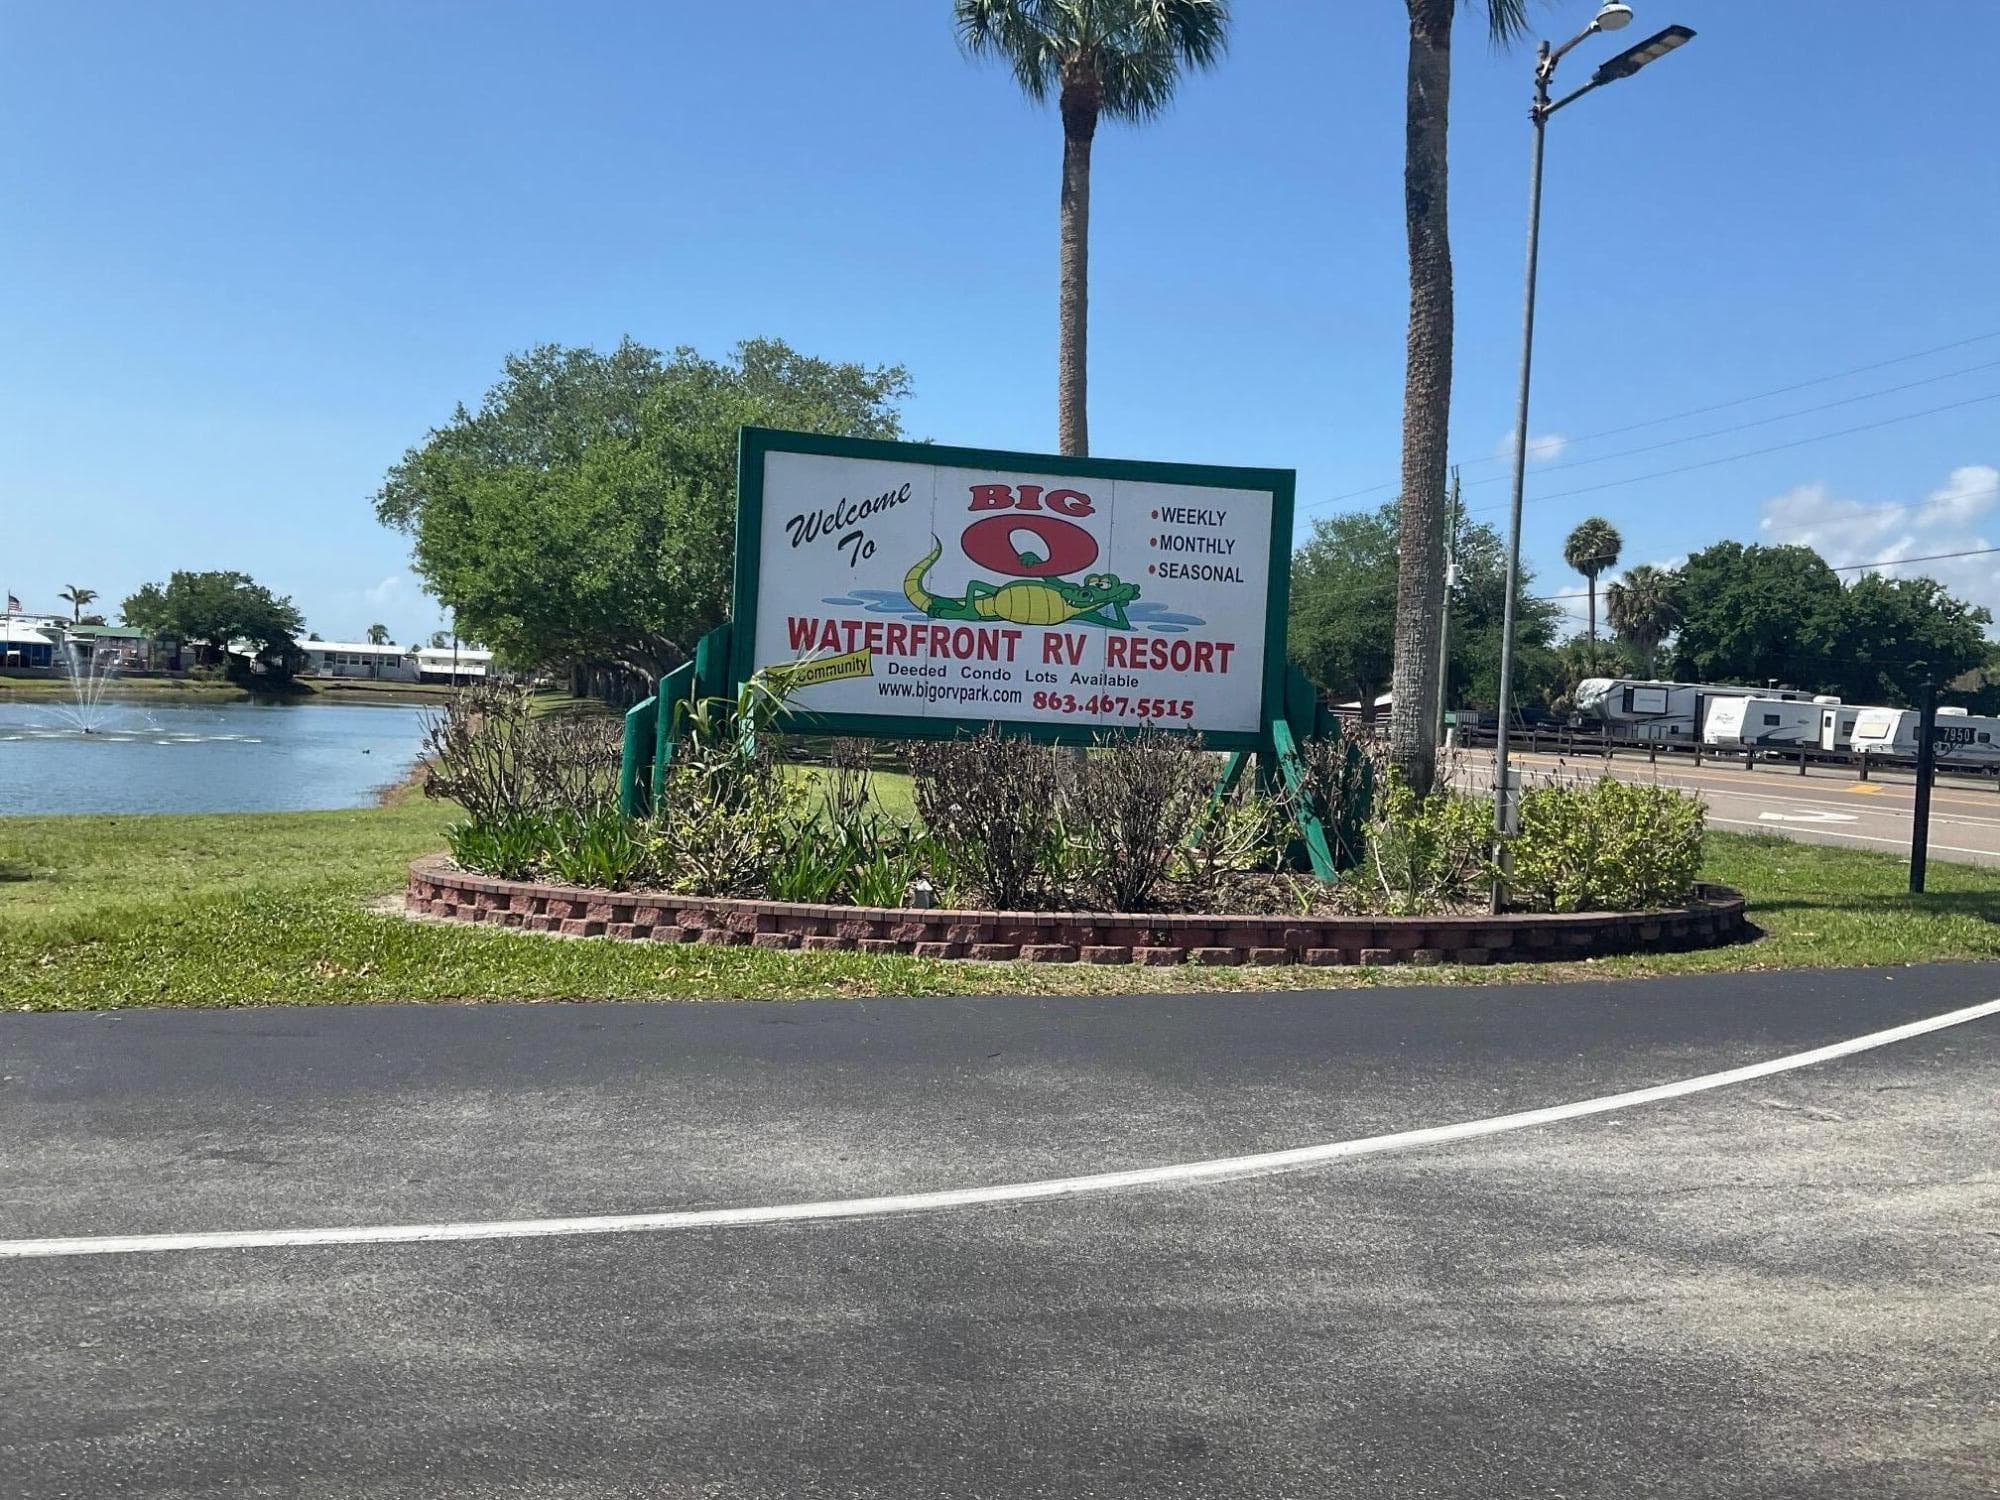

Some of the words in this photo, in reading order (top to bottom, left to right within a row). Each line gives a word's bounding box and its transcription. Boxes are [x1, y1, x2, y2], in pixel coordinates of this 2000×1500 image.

[785, 482, 911, 548] Welcome
[967, 484, 1096, 517] BIG
[1161, 506, 1227, 526] WEEKLY
[837, 530, 877, 568] To
[960, 513, 1099, 578] O
[1160, 534, 1236, 555] MONTHLY
[1158, 562, 1244, 583] SEASONAL
[787, 616, 1023, 663] WATERFRONT
[1042, 632, 1087, 666] RV
[1107, 636, 1235, 674] RESORT
[888, 662, 947, 677] Deeded
[961, 666, 1011, 681] Condo
[1025, 670, 1058, 683] Lots
[1070, 672, 1139, 688] Available
[878, 681, 1022, 704] www.bigorvpark.com
[1033, 691, 1194, 720] 863.467.5515
[1943, 728, 1970, 742] 7950
